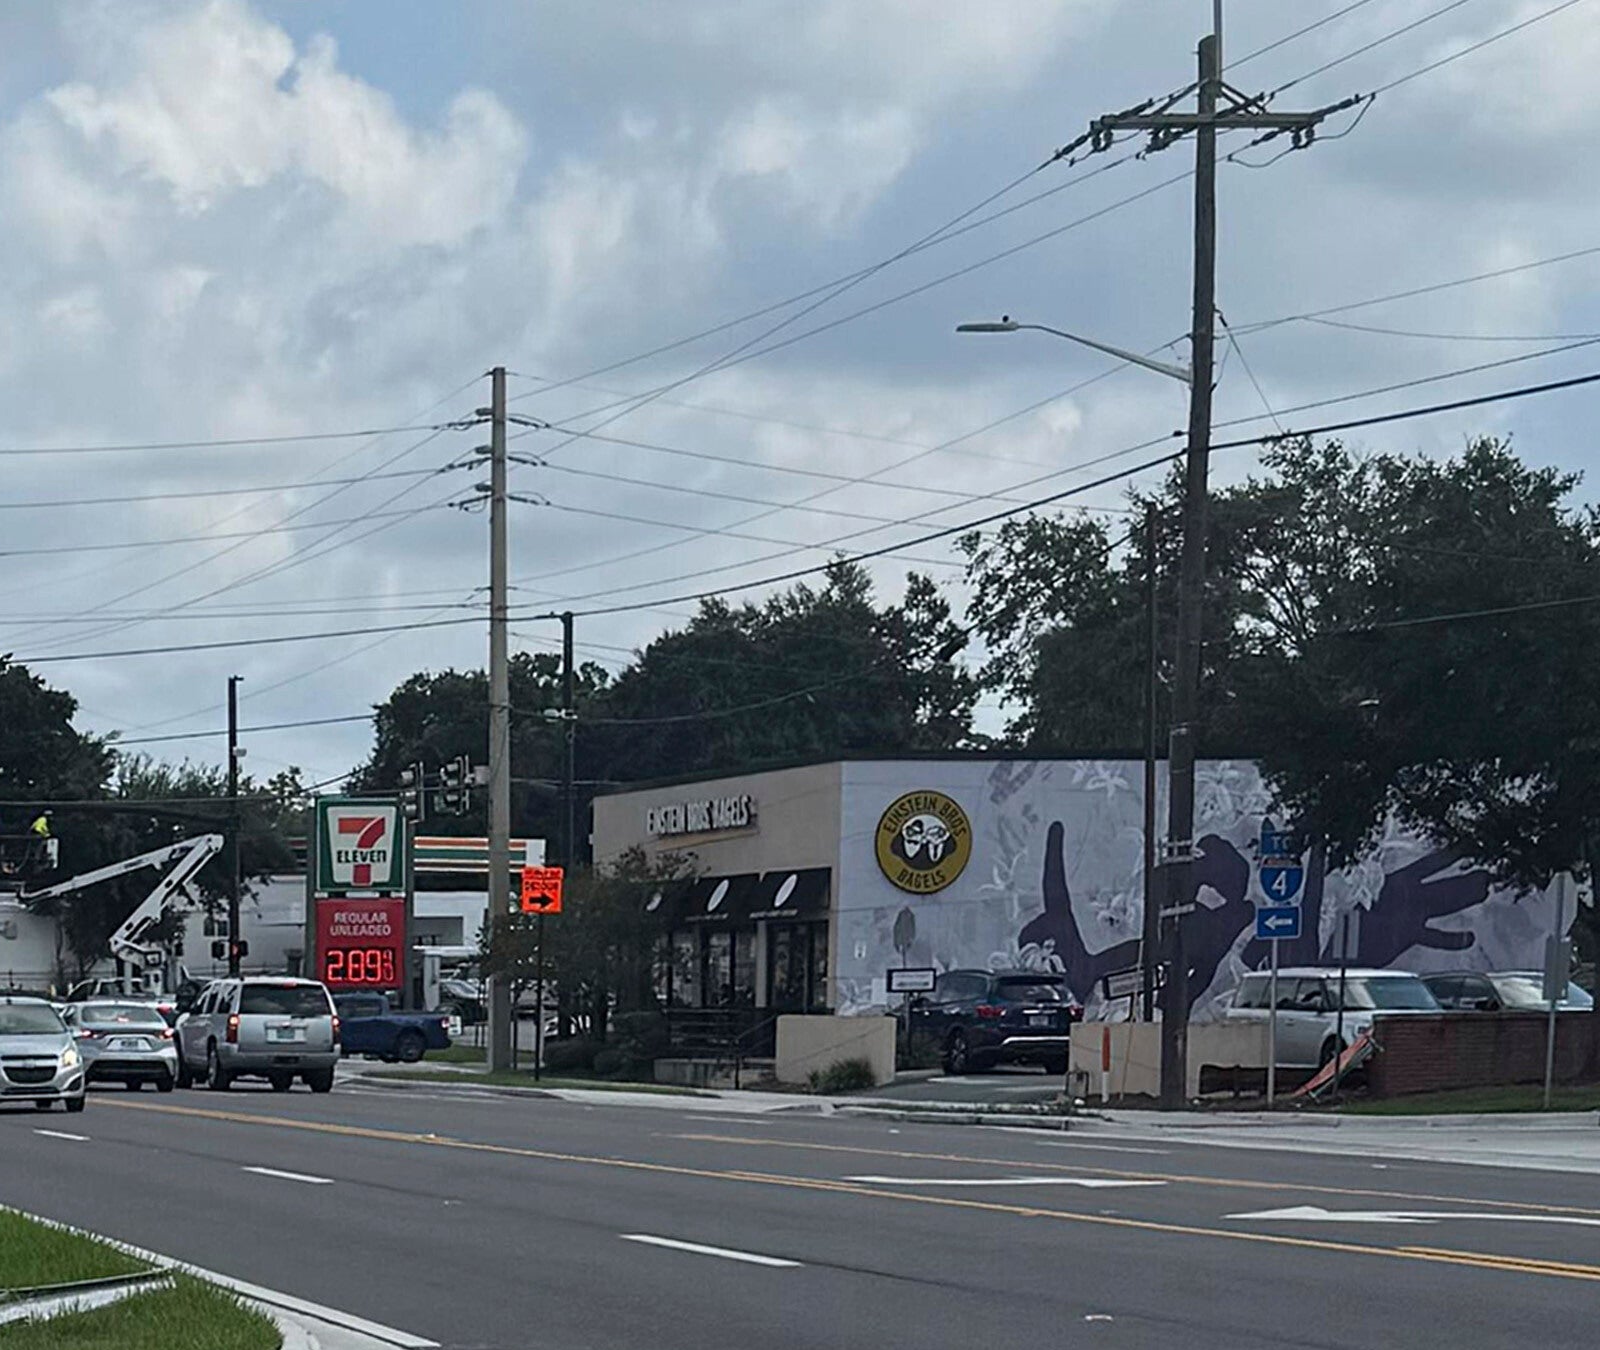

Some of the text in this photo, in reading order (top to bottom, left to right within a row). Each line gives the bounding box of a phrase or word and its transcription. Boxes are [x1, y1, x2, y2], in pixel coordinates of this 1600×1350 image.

[883, 796, 938, 834] EINSTEIN
[338, 816, 386, 885] 7
[897, 868, 946, 889] BAGELS
[1271, 869, 1287, 896] 4
[334, 911, 388, 924] REGULAR
[329, 924, 392, 936] UNLEADED
